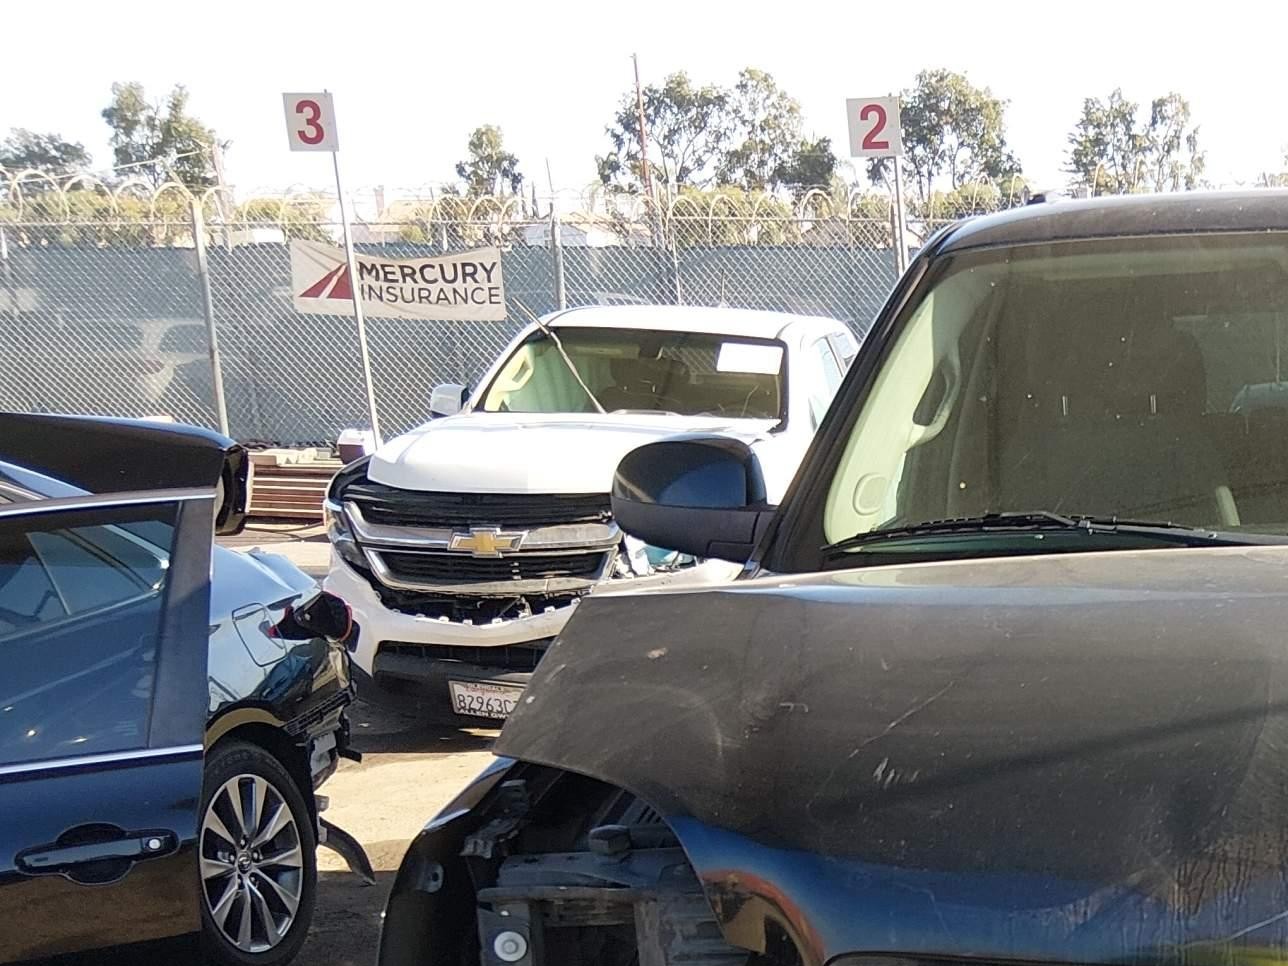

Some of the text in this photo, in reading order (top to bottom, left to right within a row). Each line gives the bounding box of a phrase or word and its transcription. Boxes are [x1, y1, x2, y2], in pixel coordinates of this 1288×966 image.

[296, 100, 324, 144] 3
[860, 104, 889, 150] 2
[358, 261, 498, 285] MERCURY
[360, 285, 502, 305] INSURANCE
[457, 694, 517, 713] 82963C
